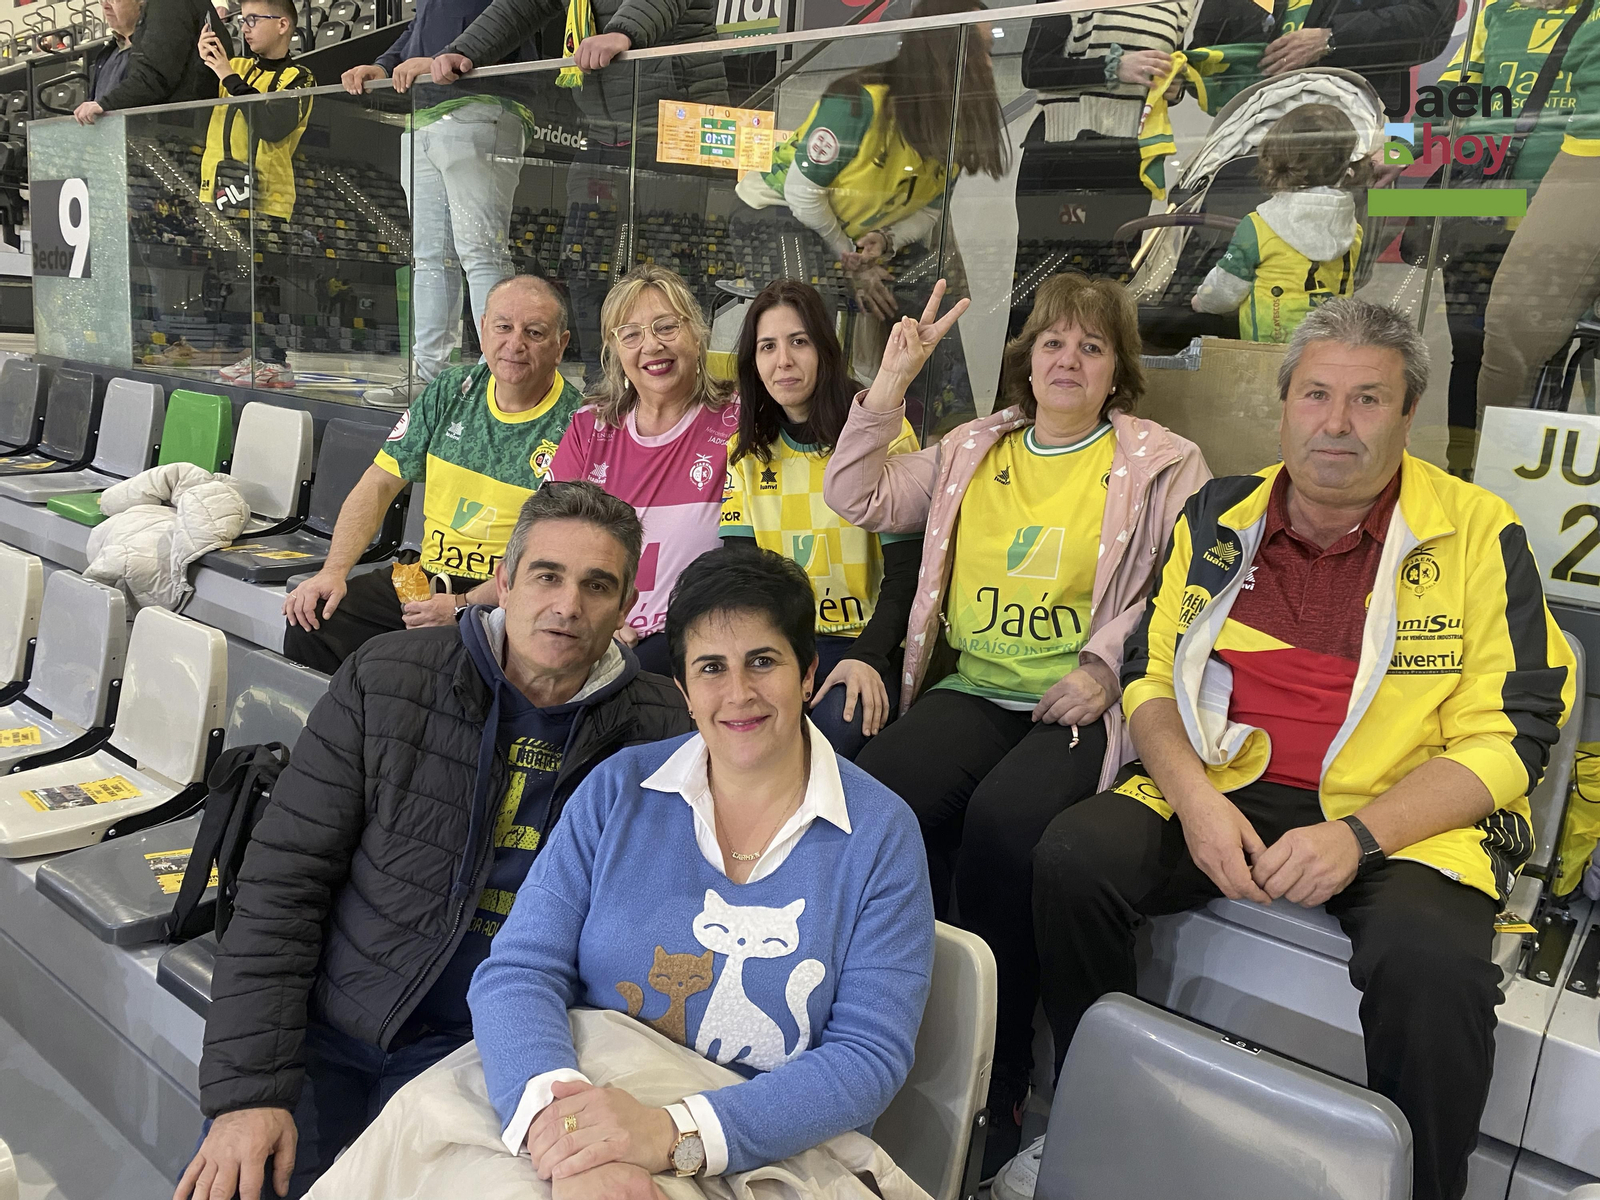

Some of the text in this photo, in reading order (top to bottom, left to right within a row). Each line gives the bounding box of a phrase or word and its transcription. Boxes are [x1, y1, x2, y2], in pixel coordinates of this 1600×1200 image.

[58, 177, 91, 279] 9
[760, 483, 778, 491] luanvi
[1202, 550, 1231, 572] luanv
[971, 586, 1082, 642] Jaén
